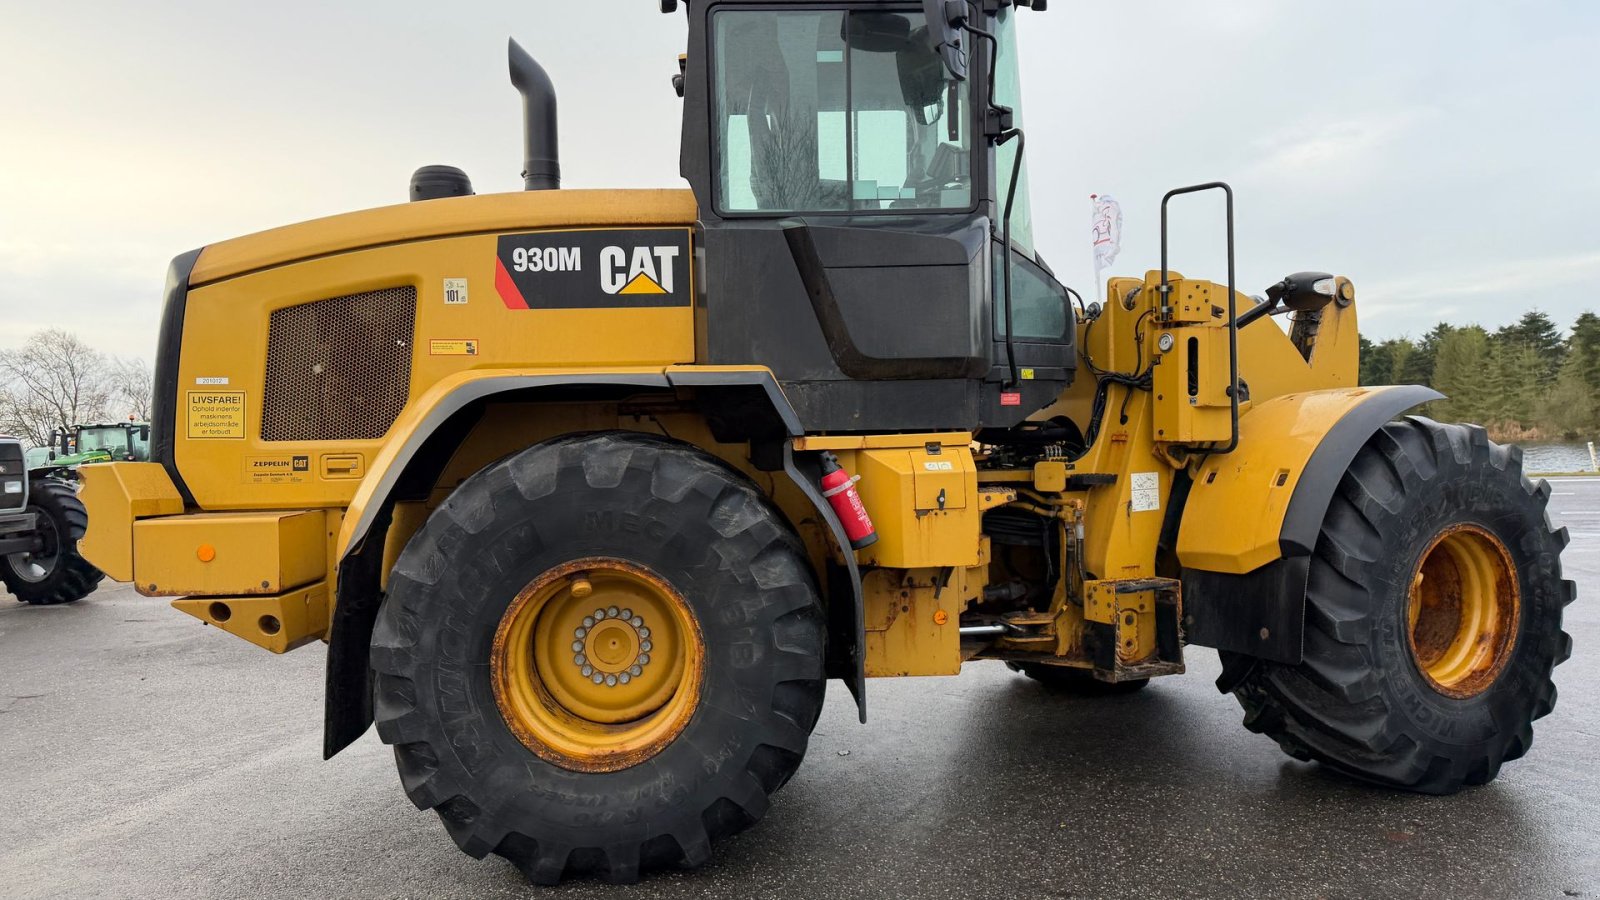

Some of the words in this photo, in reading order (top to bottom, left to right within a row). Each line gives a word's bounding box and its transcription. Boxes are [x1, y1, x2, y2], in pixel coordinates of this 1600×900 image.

[512, 247, 581, 272] 930M
[600, 245, 679, 294] CAT
[446, 289, 459, 302] 101
[192, 396, 241, 404] LIVSFARE!
[294, 459, 307, 468] CAT
